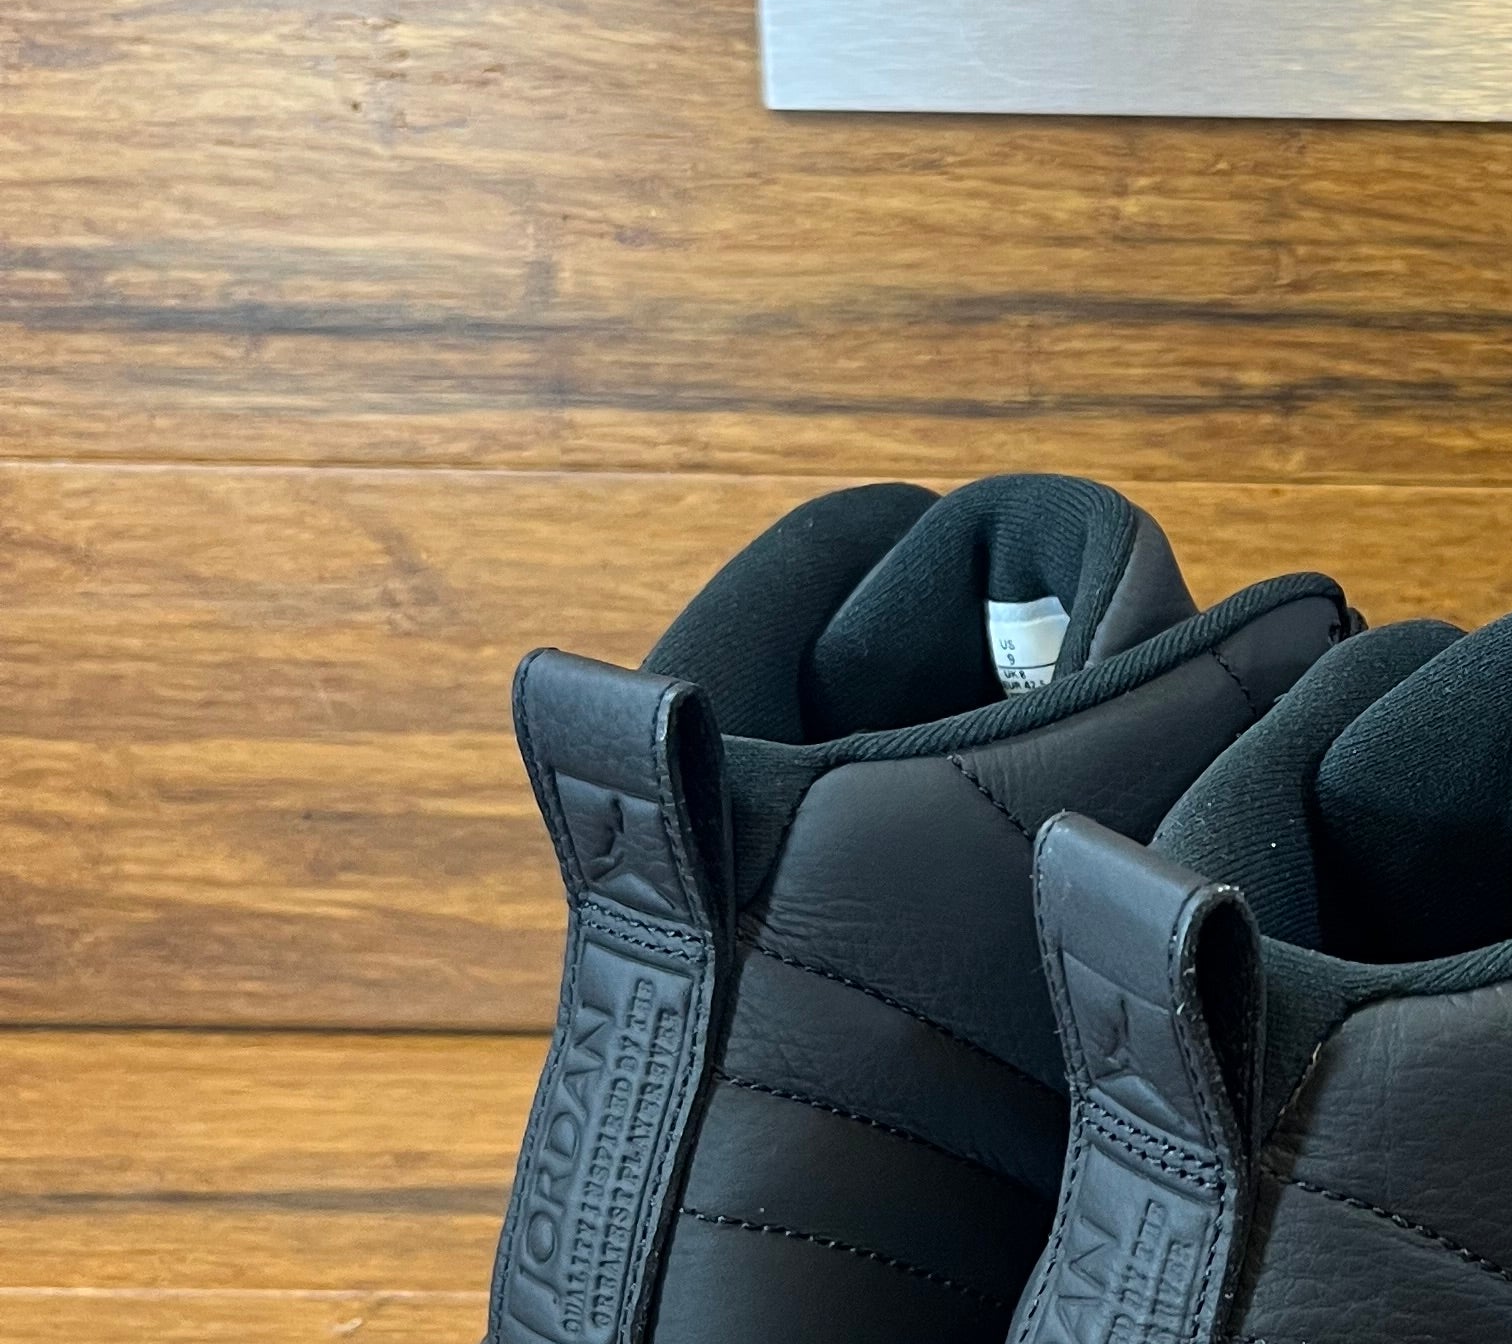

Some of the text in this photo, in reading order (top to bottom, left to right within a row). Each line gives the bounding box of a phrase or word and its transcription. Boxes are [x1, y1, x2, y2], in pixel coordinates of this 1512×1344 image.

[1000, 639, 1015, 650] US
[1007, 653, 1015, 665] 9
[515, 999, 617, 1306] JORDAN
[561, 1218, 597, 1333] QUALITY
[581, 1077, 633, 1212] INSPIRED
[591, 1187, 634, 1328] GREATEST
[616, 1083, 663, 1181] PLAYER
